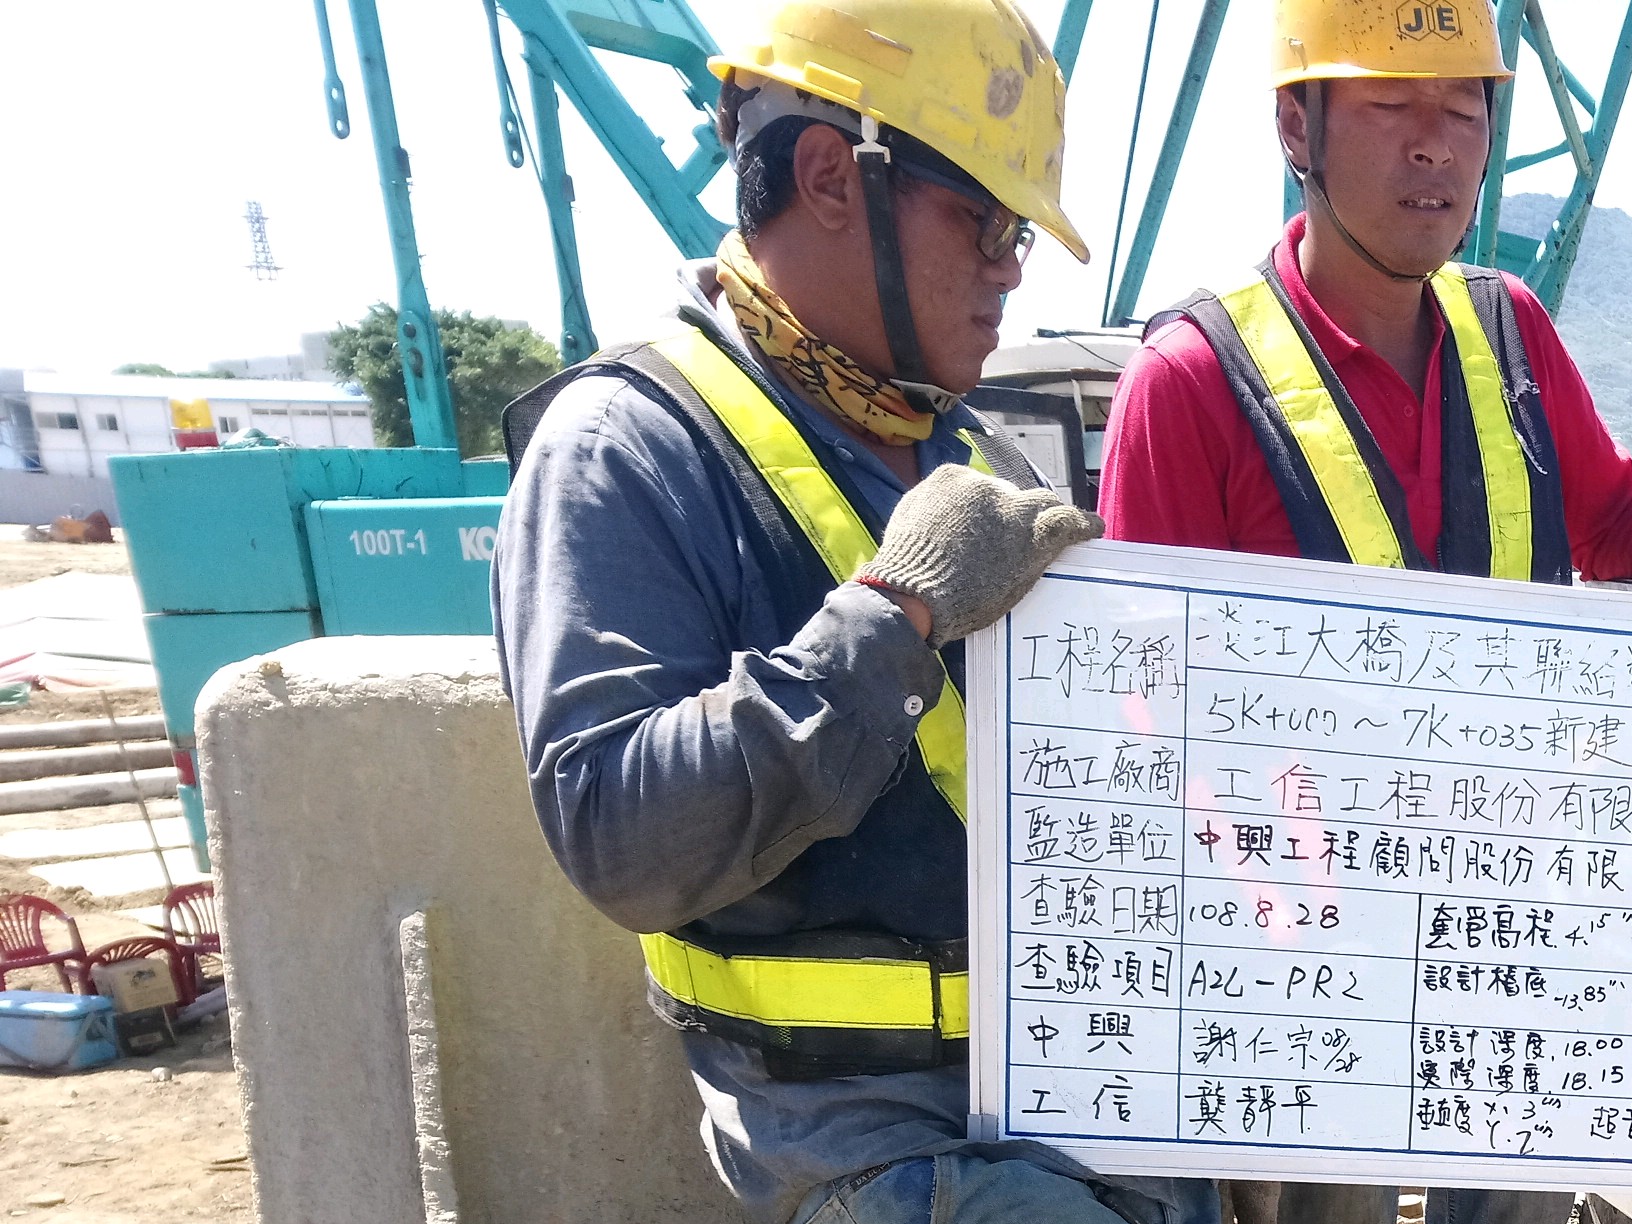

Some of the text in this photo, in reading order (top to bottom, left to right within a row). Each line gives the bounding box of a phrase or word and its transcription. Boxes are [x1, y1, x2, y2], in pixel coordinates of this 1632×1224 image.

[350, 529, 428, 555] 100T-1
[1017, 621, 1181, 699] 工程名稱
[1020, 738, 1180, 802] 施工廠商
[1023, 804, 1177, 866] 監造單位
[1020, 872, 1179, 937] 查驗日期
[1188, 896, 1341, 929] 108.8.28
[1014, 942, 1172, 998] 查驗項目
[1027, 1012, 1136, 1059] 中興
[1021, 1075, 1134, 1123] 工信
